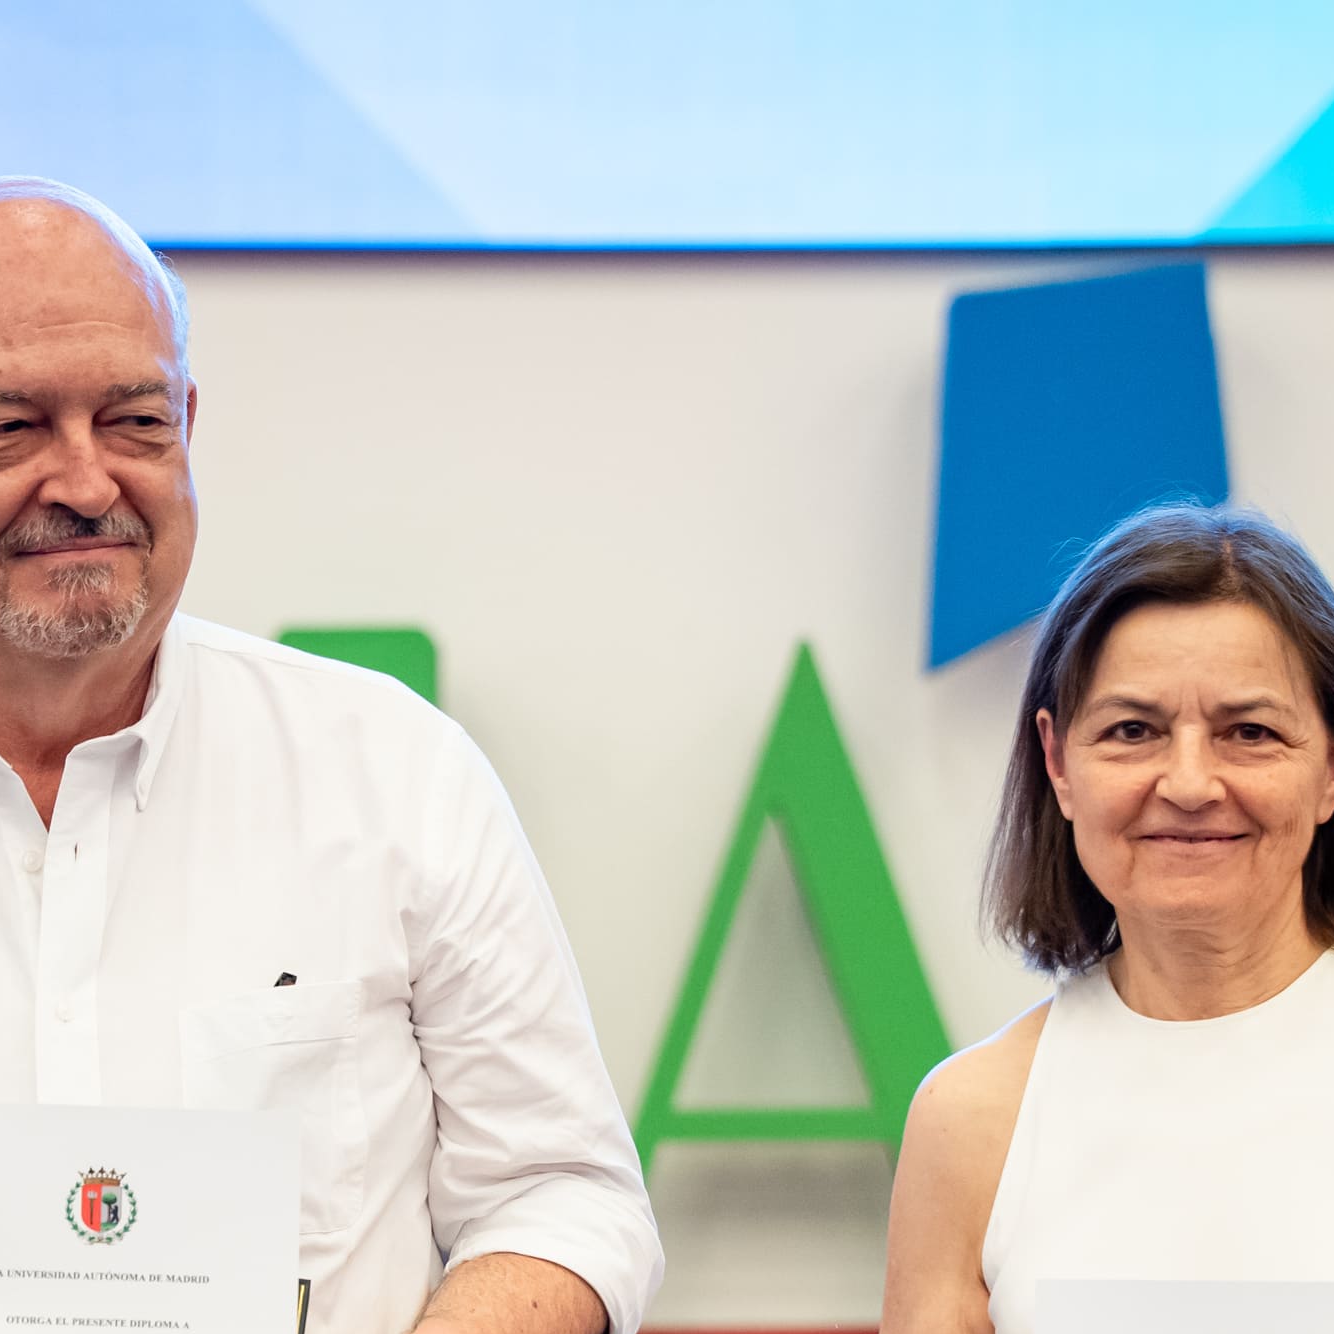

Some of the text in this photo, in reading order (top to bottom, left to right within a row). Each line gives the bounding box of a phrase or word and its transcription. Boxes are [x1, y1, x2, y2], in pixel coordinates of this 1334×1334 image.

[7, 1269, 80, 1280] UNIVERSIDAD
[83, 1270, 146, 1282] AUTÓNOMA
[149, 1273, 163, 1283] DE
[166, 1274, 210, 1284] MADRID
[6, 1315, 190, 1330] OTORGA EL PRESENTE DIPLOMA A
